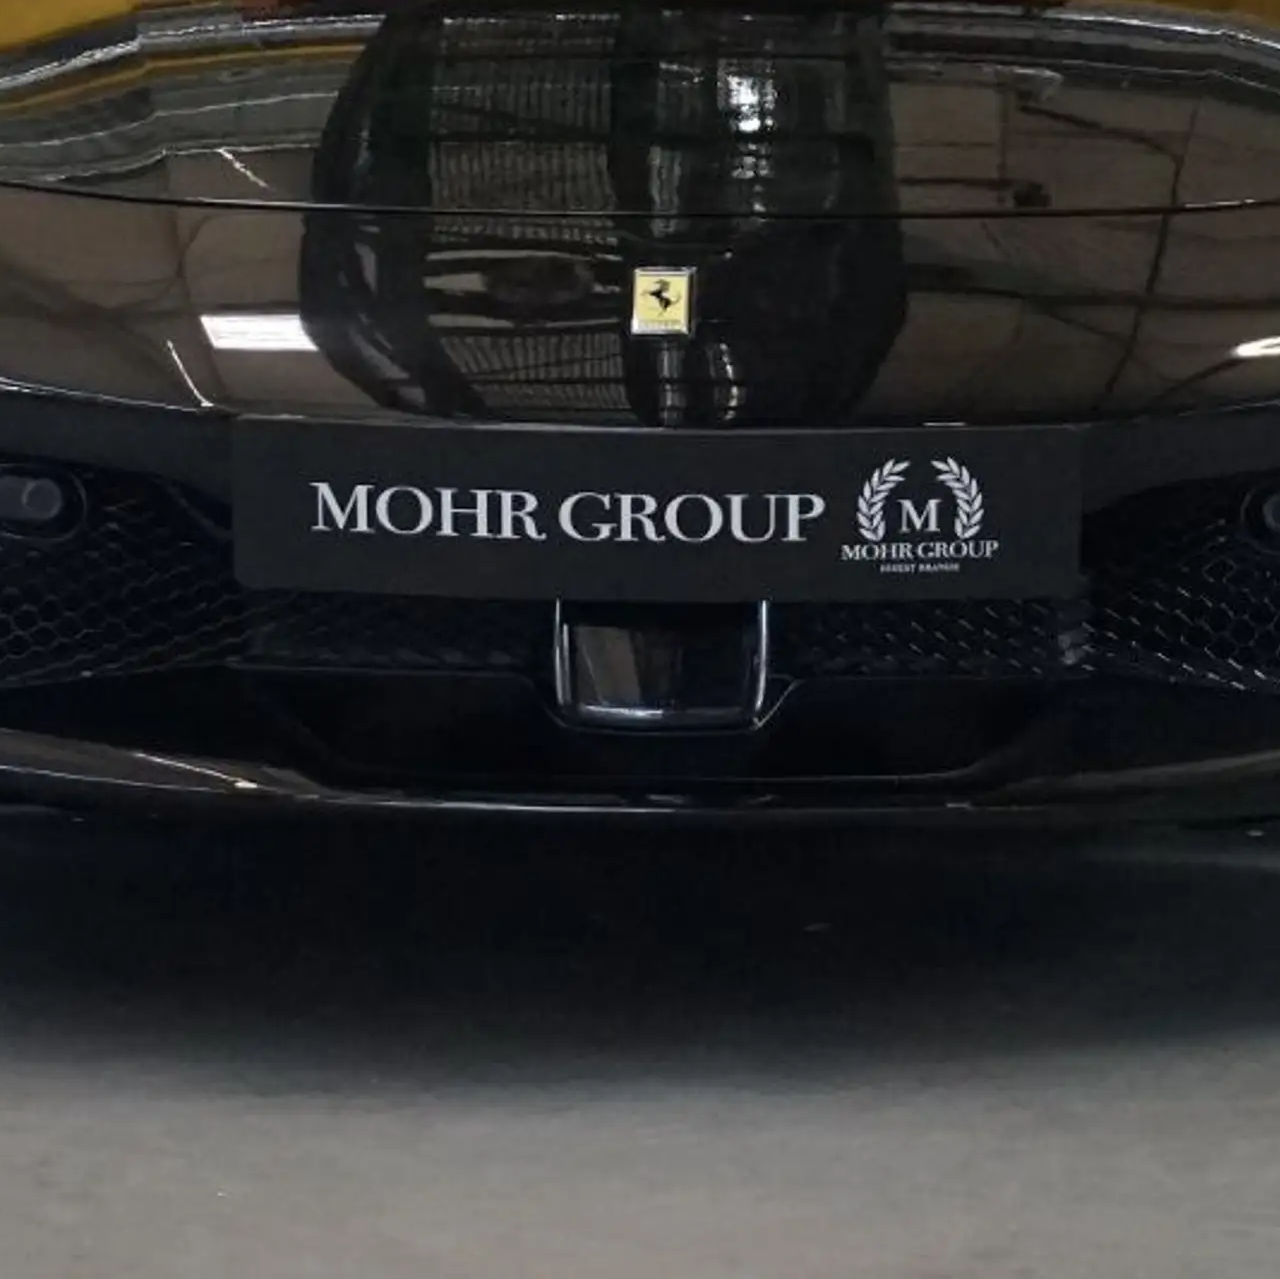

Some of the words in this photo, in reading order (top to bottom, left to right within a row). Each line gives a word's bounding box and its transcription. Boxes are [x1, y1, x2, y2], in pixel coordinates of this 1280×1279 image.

[309, 482, 547, 541] MOHR
[558, 491, 826, 543] GROUP
[898, 499, 942, 533] M
[841, 543, 913, 560] MOHR
[917, 540, 999, 558] GROUP
